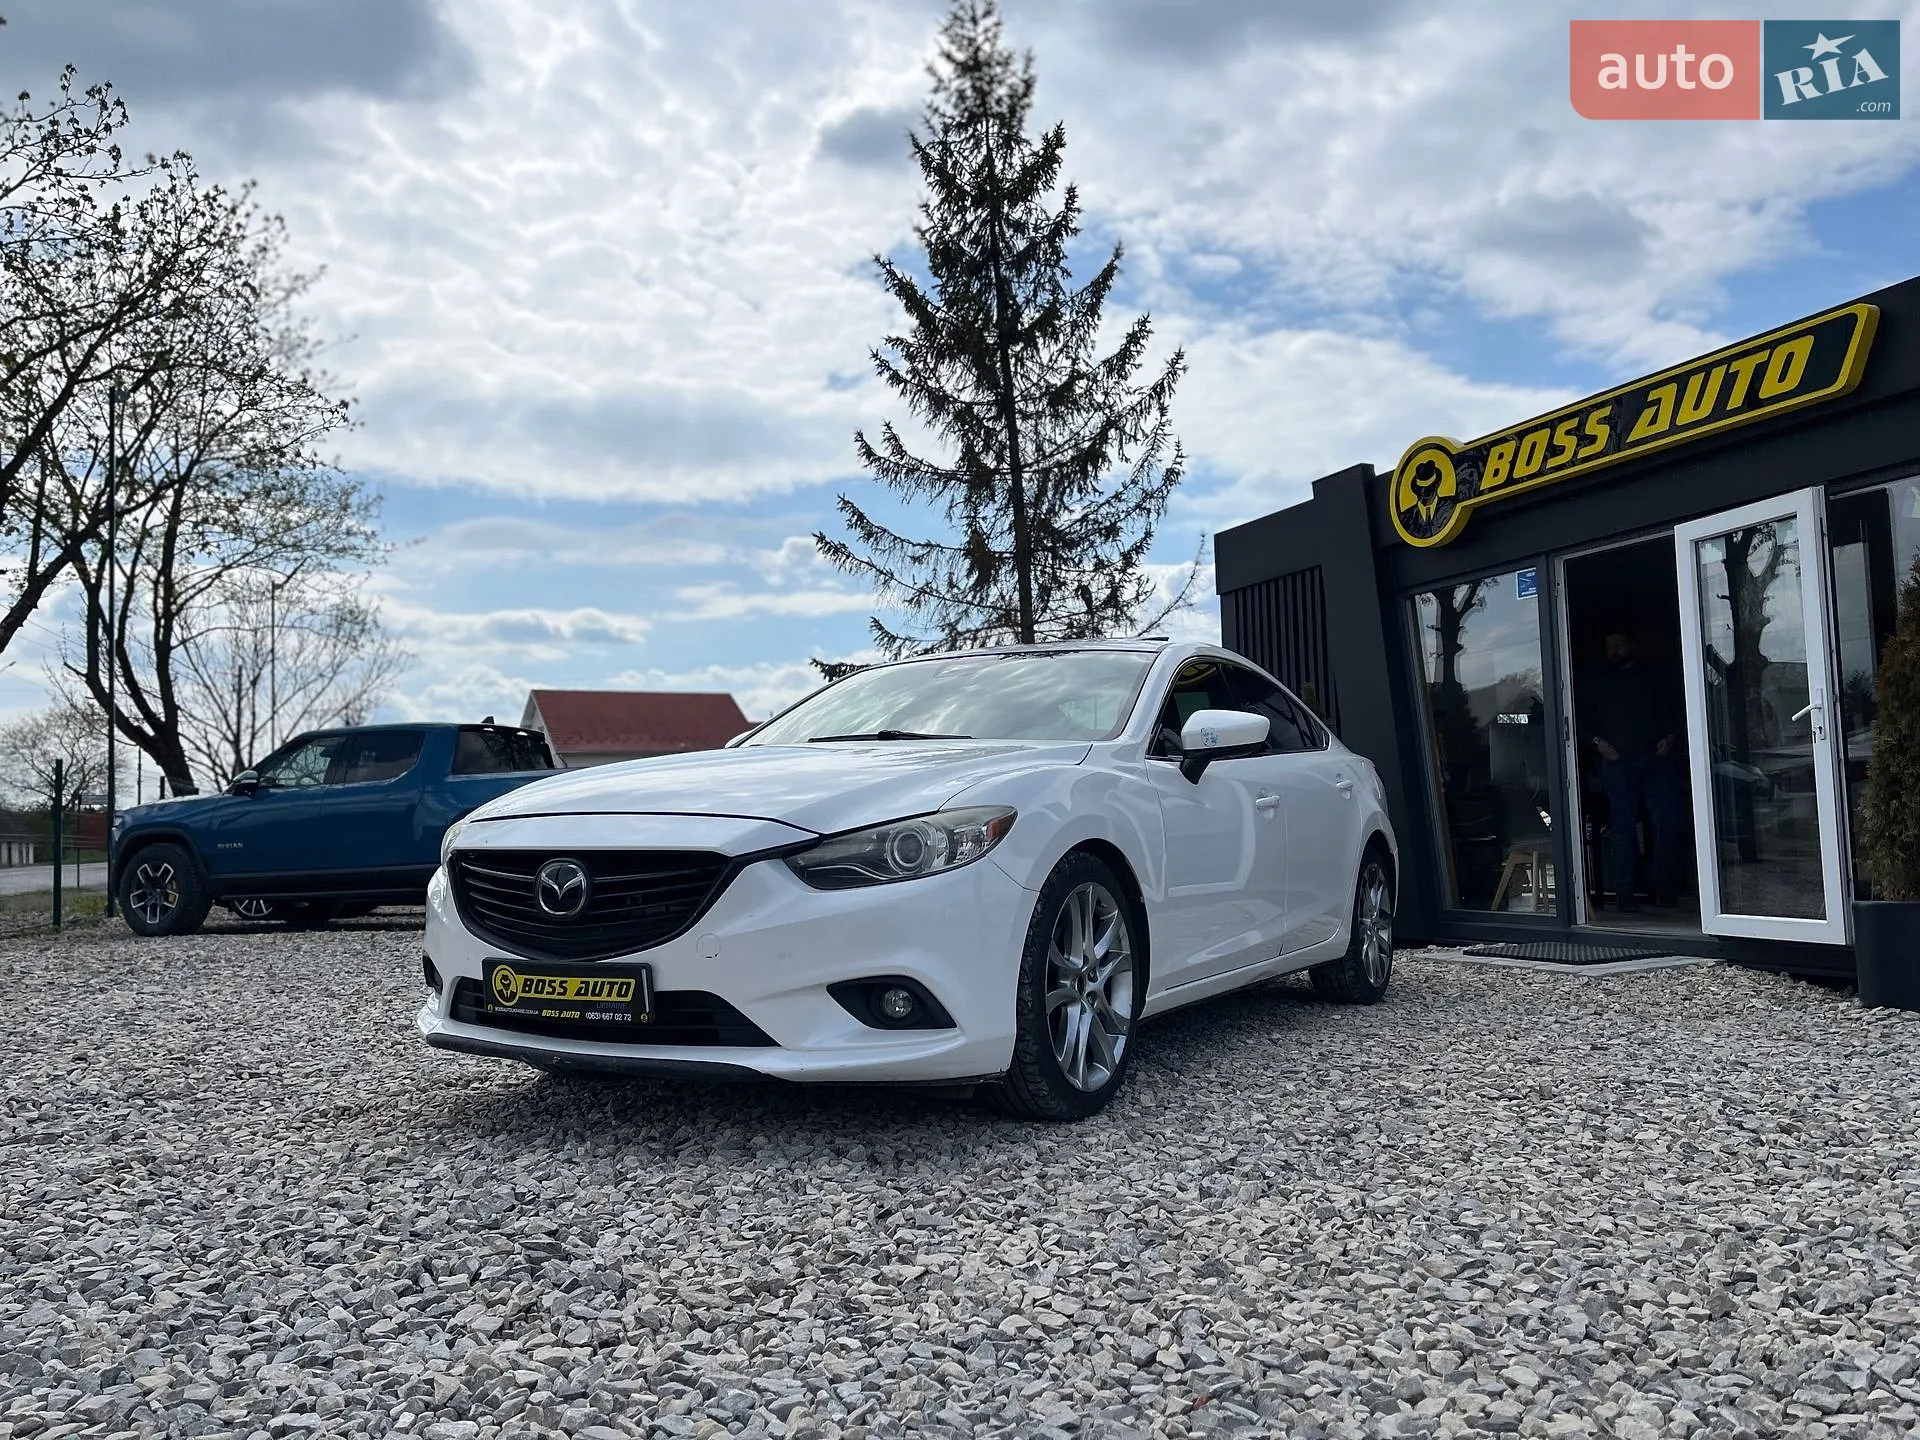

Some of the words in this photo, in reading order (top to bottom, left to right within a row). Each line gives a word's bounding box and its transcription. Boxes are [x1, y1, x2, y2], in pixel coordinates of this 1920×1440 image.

[1480, 405, 1612, 491] BOSS
[1625, 335, 1814, 443] AUTO
[520, 977, 569, 997] BOSS
[573, 980, 633, 998] AUTO
[541, 1009, 560, 1018] BOSS
[560, 1010, 581, 1019] AUTO
[614, 1013, 623, 1021] 02
[623, 1013, 632, 1022] 72
